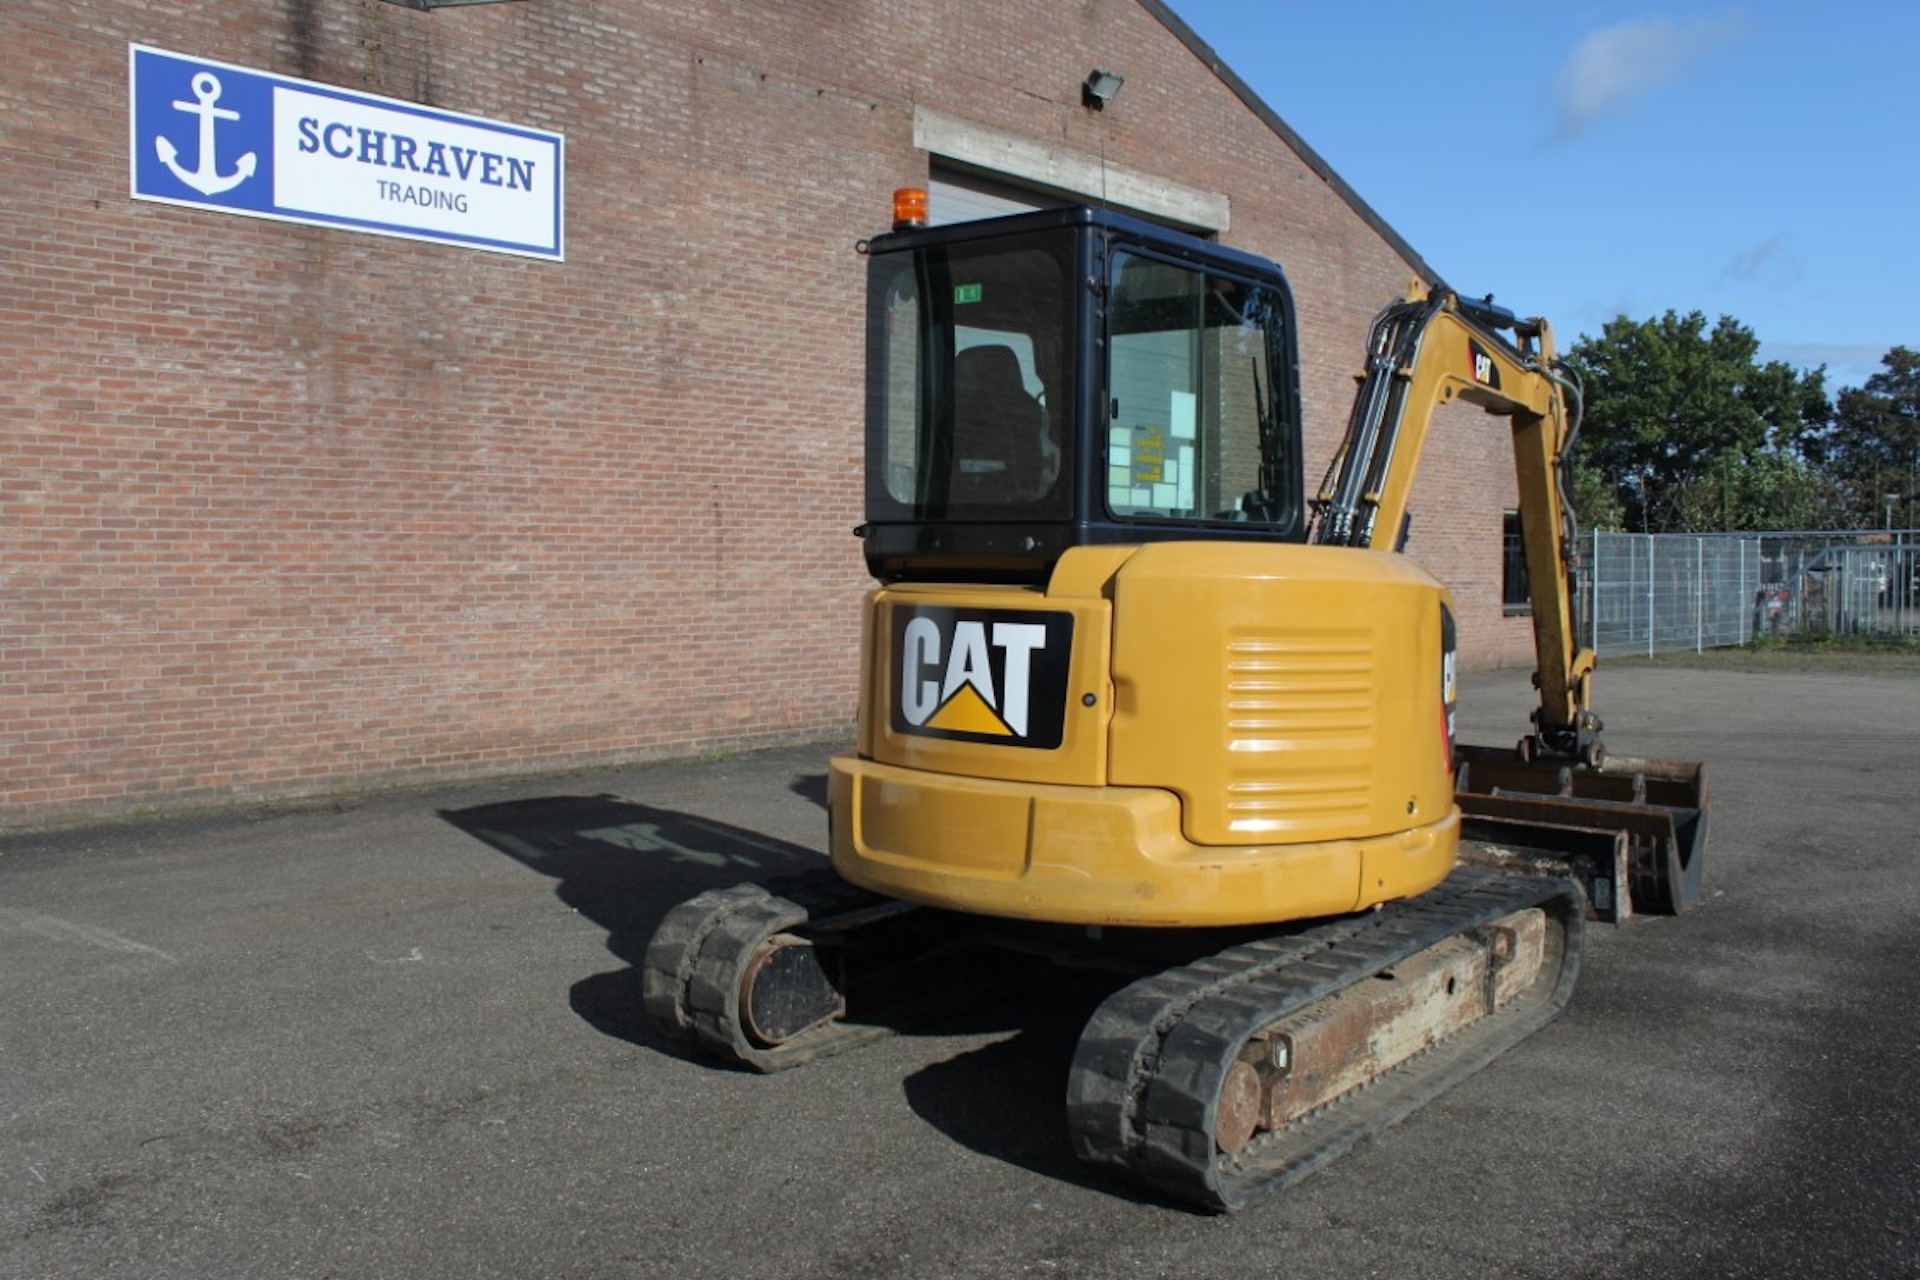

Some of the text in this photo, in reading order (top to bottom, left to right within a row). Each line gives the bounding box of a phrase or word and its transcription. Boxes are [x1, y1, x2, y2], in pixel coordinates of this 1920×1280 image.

[298, 117, 535, 191] SCHRAVEN
[377, 180, 467, 213] TRADING
[902, 616, 1046, 738] CAT
